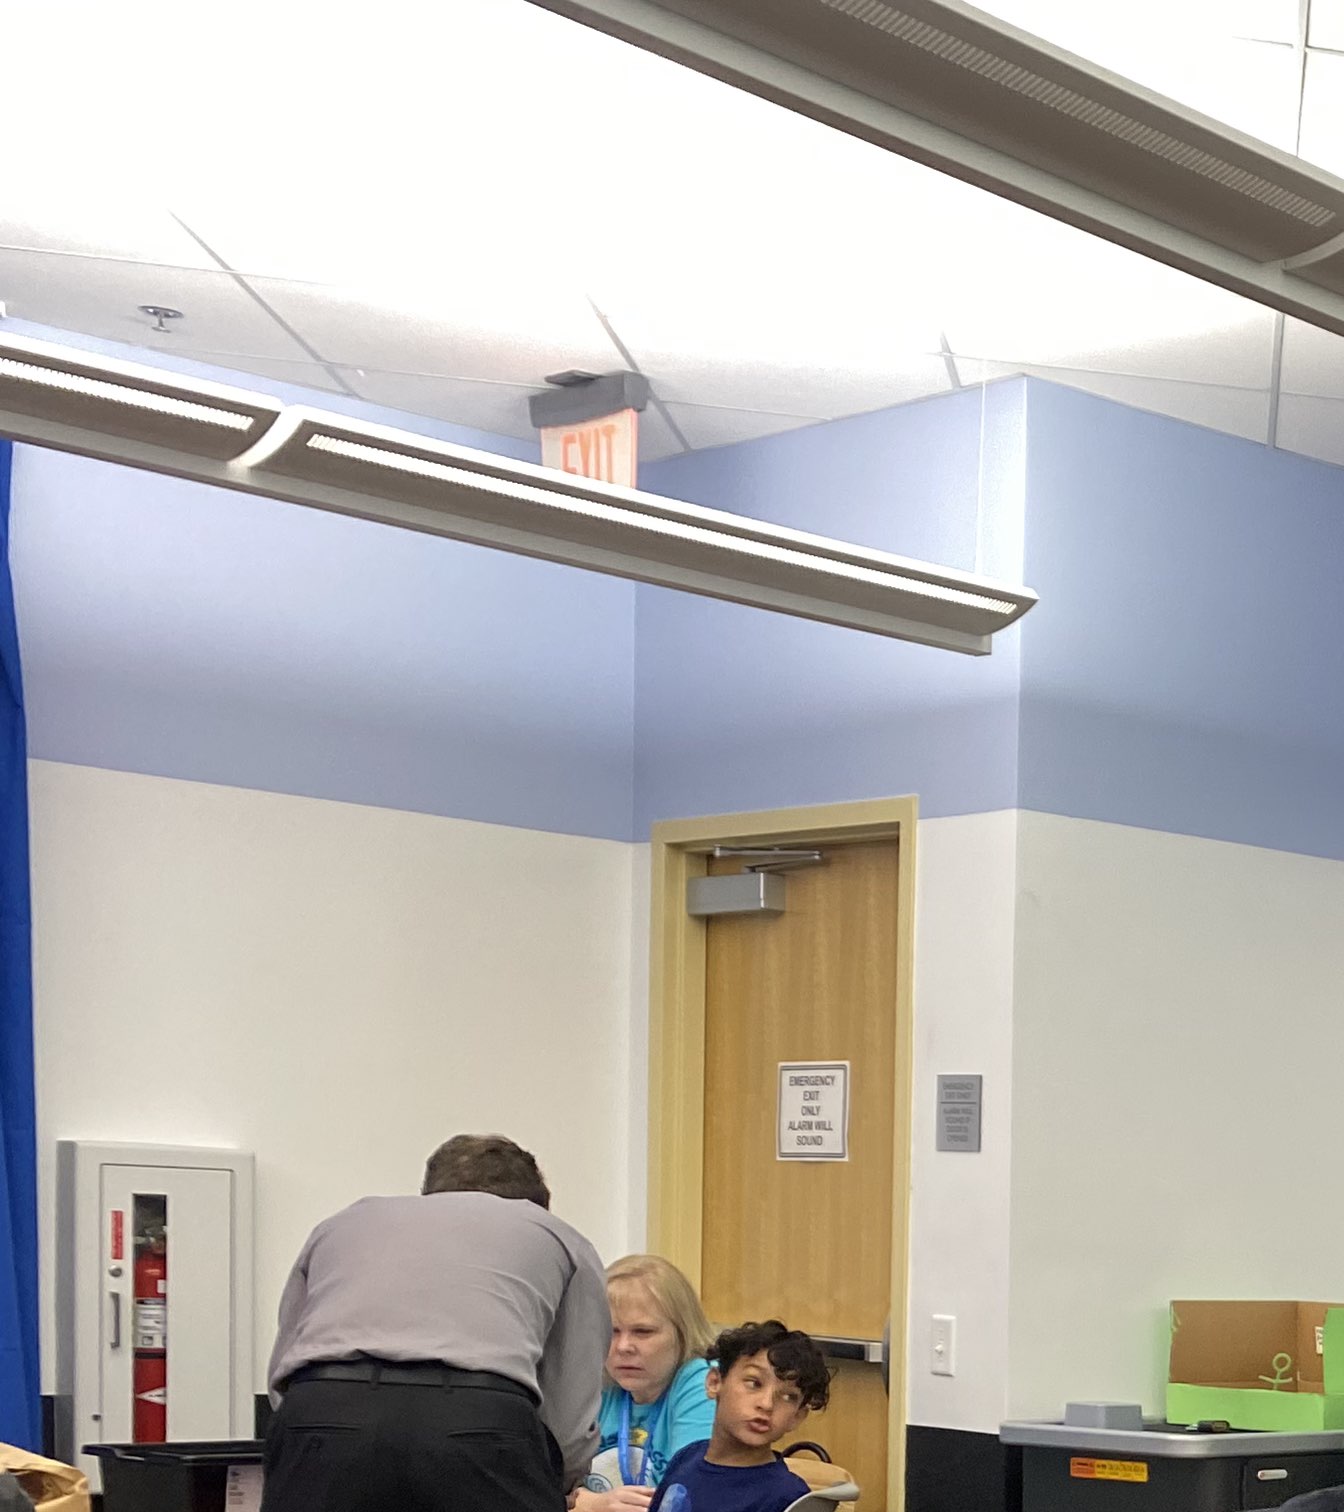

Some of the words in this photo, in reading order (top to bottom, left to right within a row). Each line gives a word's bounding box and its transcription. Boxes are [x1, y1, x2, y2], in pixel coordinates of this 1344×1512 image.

[788, 1075, 835, 1087] EMERGENCY
[803, 1090, 820, 1101] EXIT
[801, 1105, 820, 1117] ONLY
[787, 1120, 813, 1132] ALARM
[814, 1120, 833, 1132] WILL
[796, 1135, 823, 1146] SOUND
